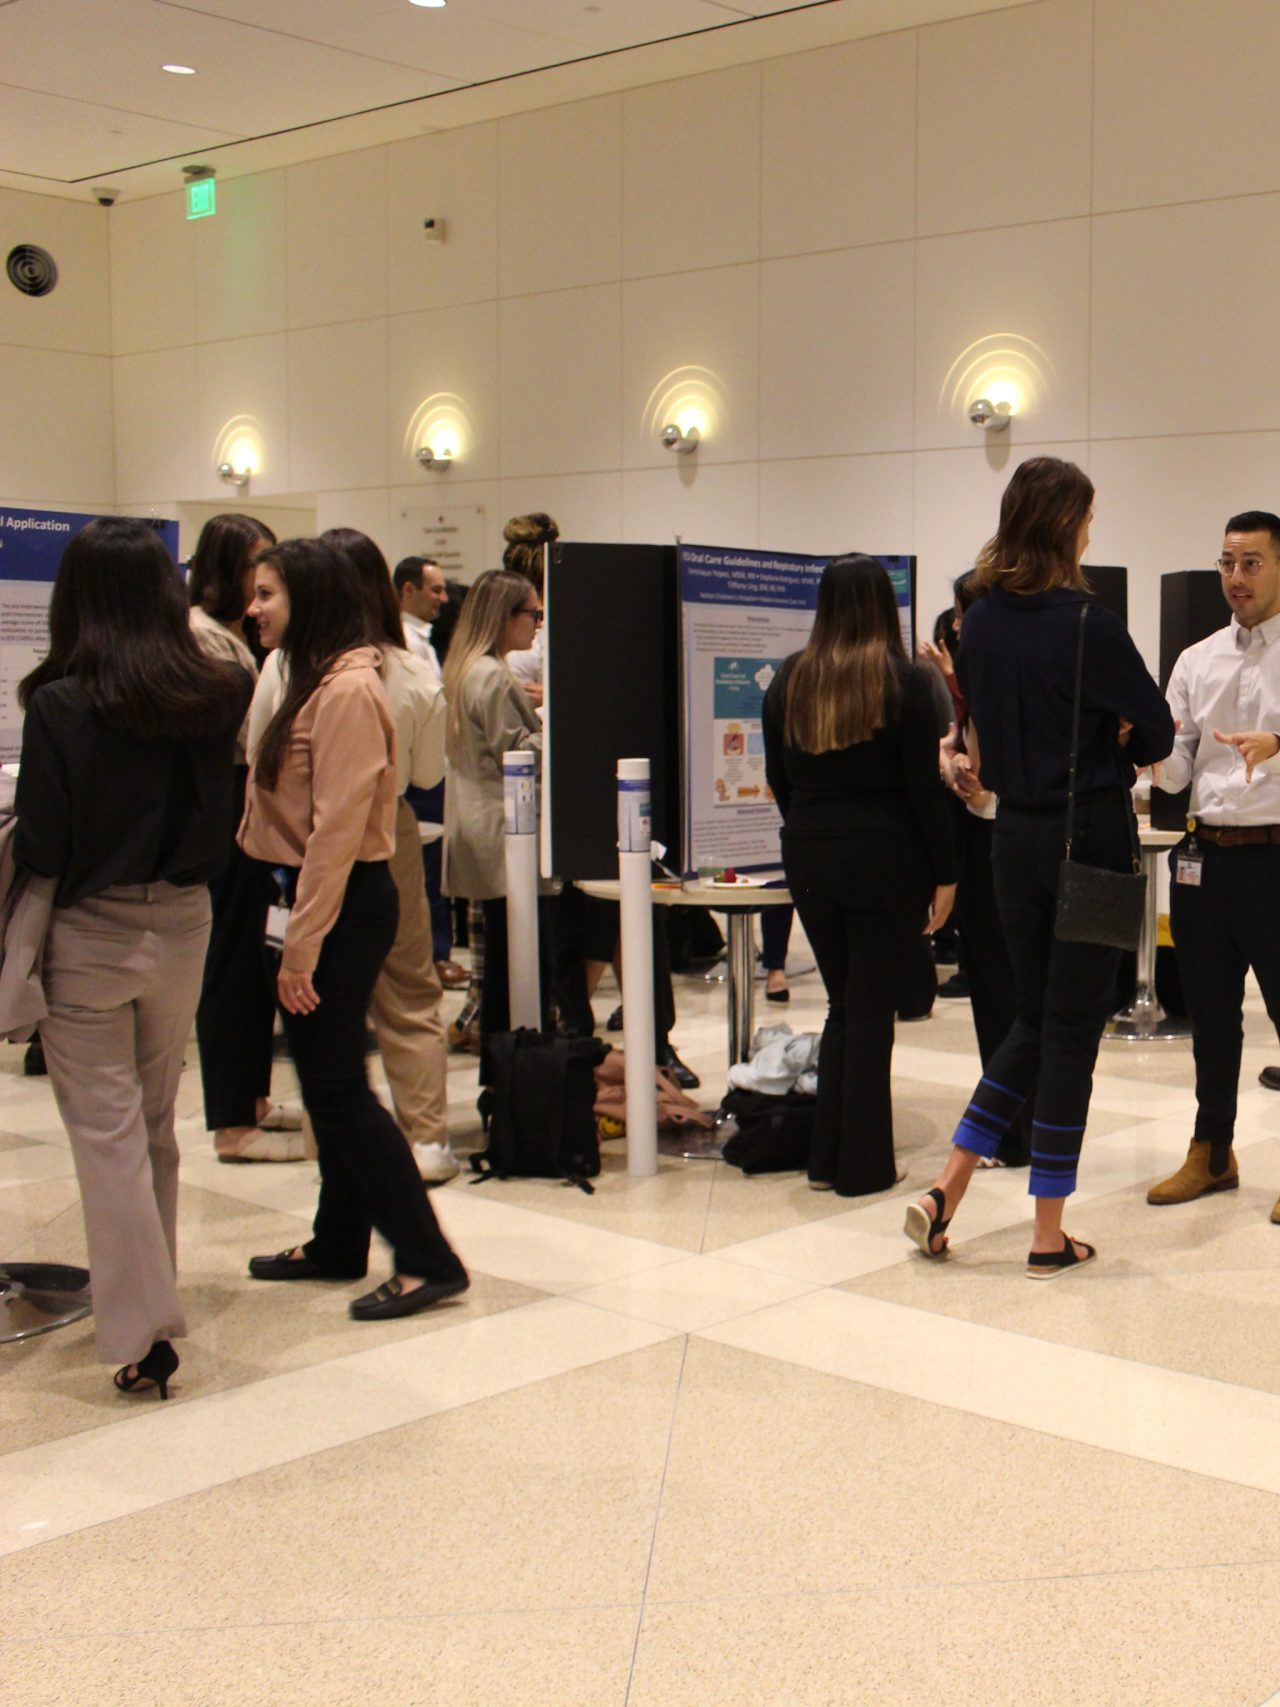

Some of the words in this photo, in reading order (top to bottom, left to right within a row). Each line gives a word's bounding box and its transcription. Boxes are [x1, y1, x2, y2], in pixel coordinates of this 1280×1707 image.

[6, 516, 70, 531] Application
[705, 553, 722, 565] Care
[723, 555, 761, 569] Guidelines
